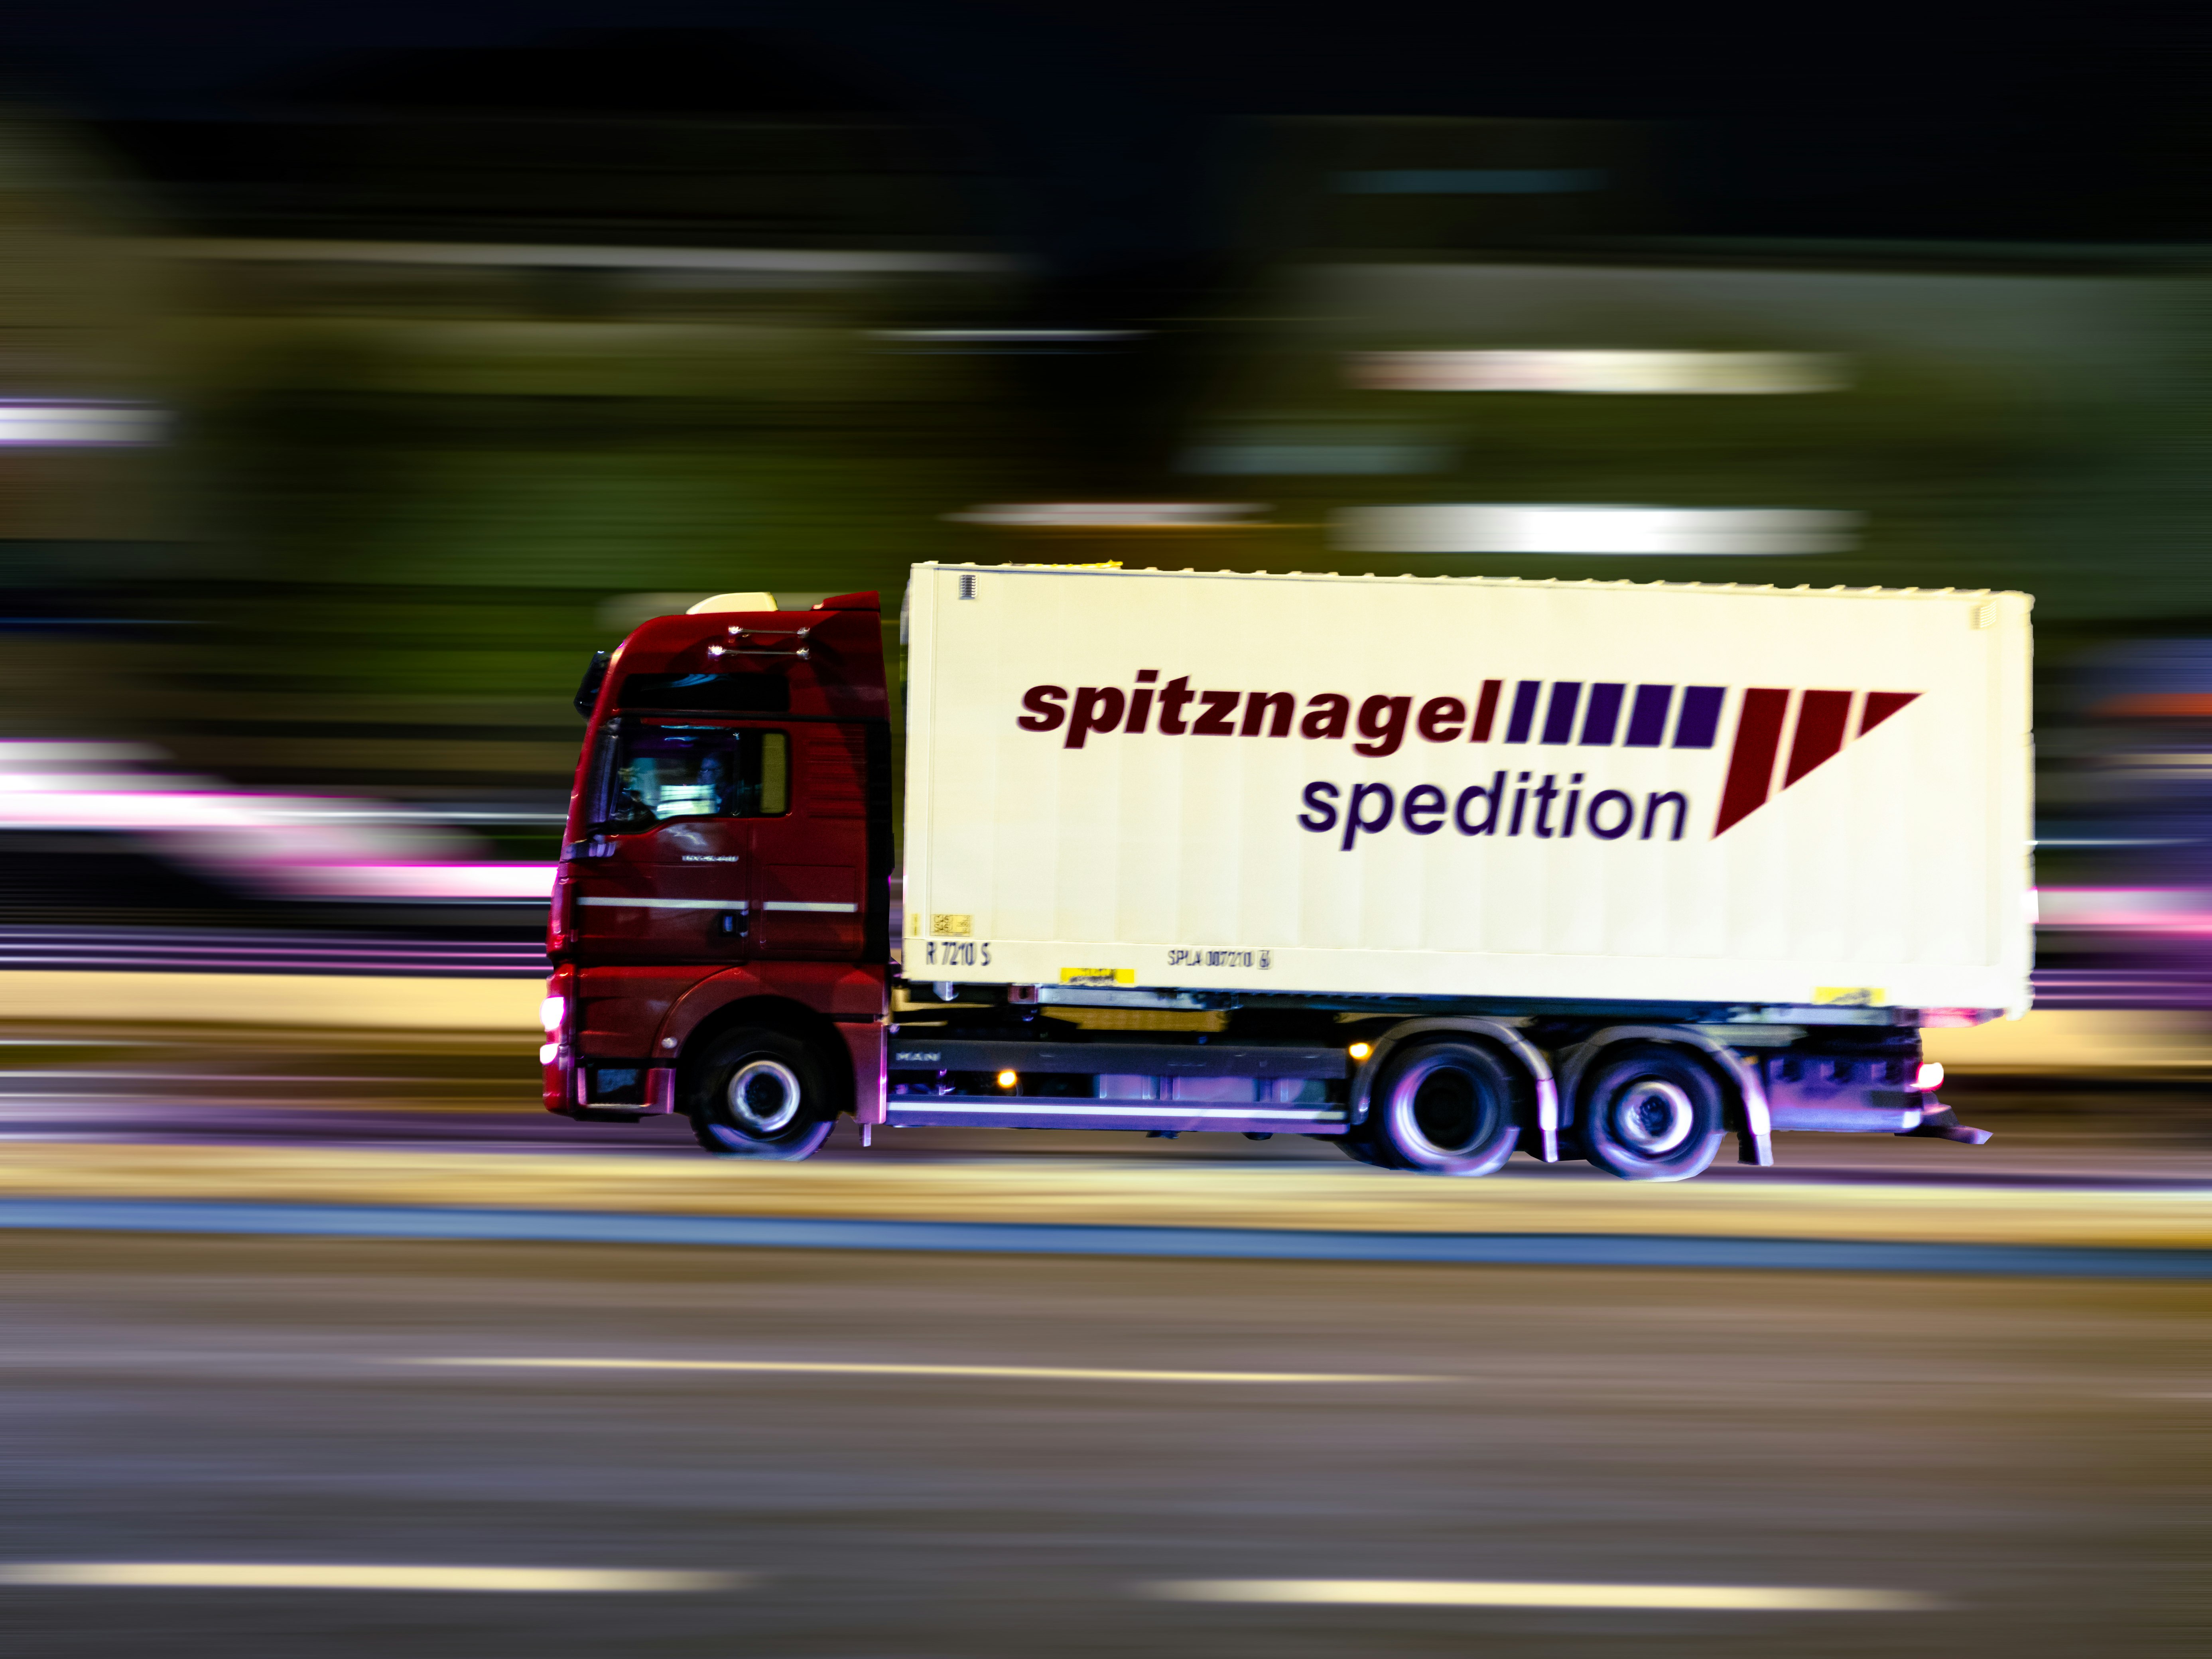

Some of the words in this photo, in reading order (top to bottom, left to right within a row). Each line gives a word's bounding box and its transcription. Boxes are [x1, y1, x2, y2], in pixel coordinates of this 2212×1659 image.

[1017, 669, 1503, 758] spitznagel
[1298, 770, 1688, 852] spedition
[926, 942, 937, 965] R
[942, 942, 977, 966] 7210
[981, 942, 992, 966] S
[1168, 950, 1202, 966] SPLA
[1206, 951, 1254, 967] 007210
[896, 1051, 941, 1061] MAN
